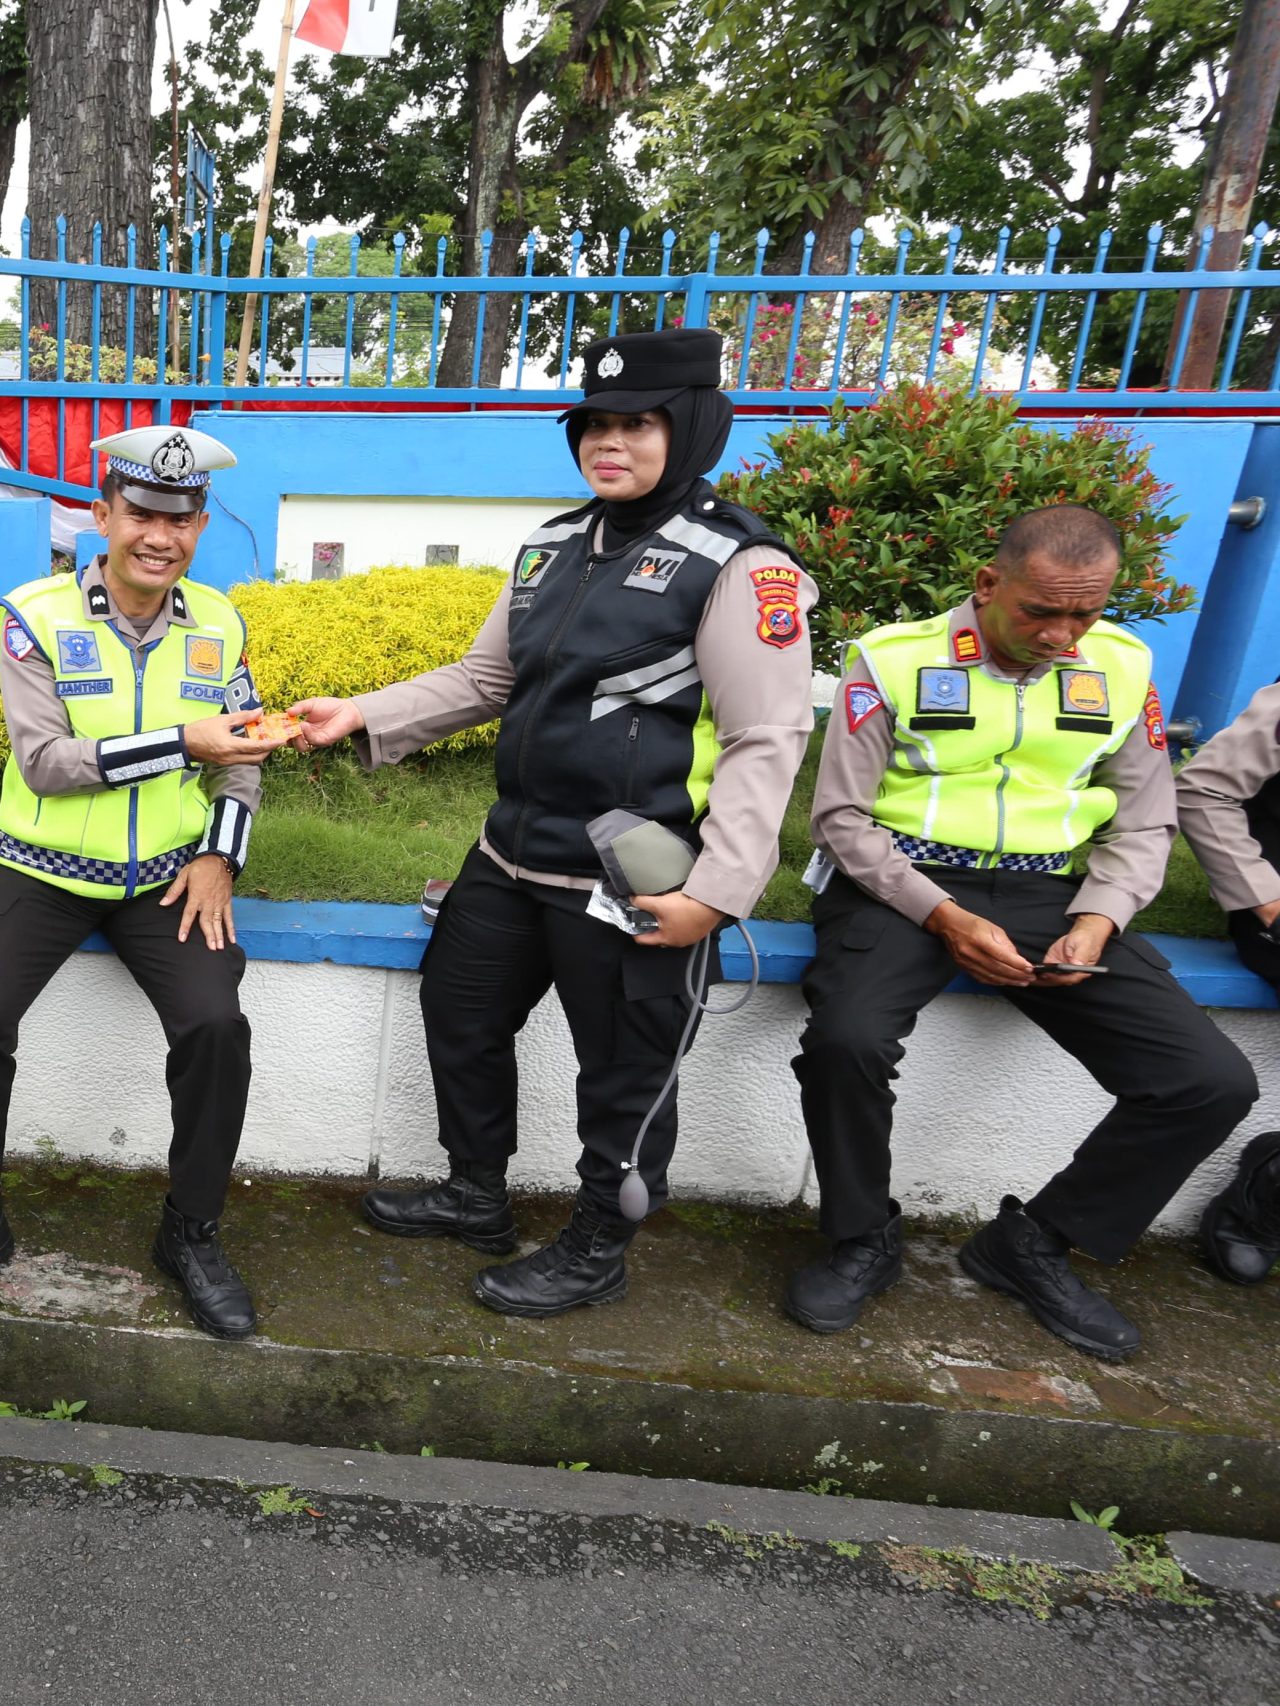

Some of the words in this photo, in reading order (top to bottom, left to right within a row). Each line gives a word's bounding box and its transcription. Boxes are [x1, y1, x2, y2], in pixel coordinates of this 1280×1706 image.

[634, 556, 680, 577] DVI
[754, 568, 796, 583] POLDA
[60, 681, 110, 694] JANTHER
